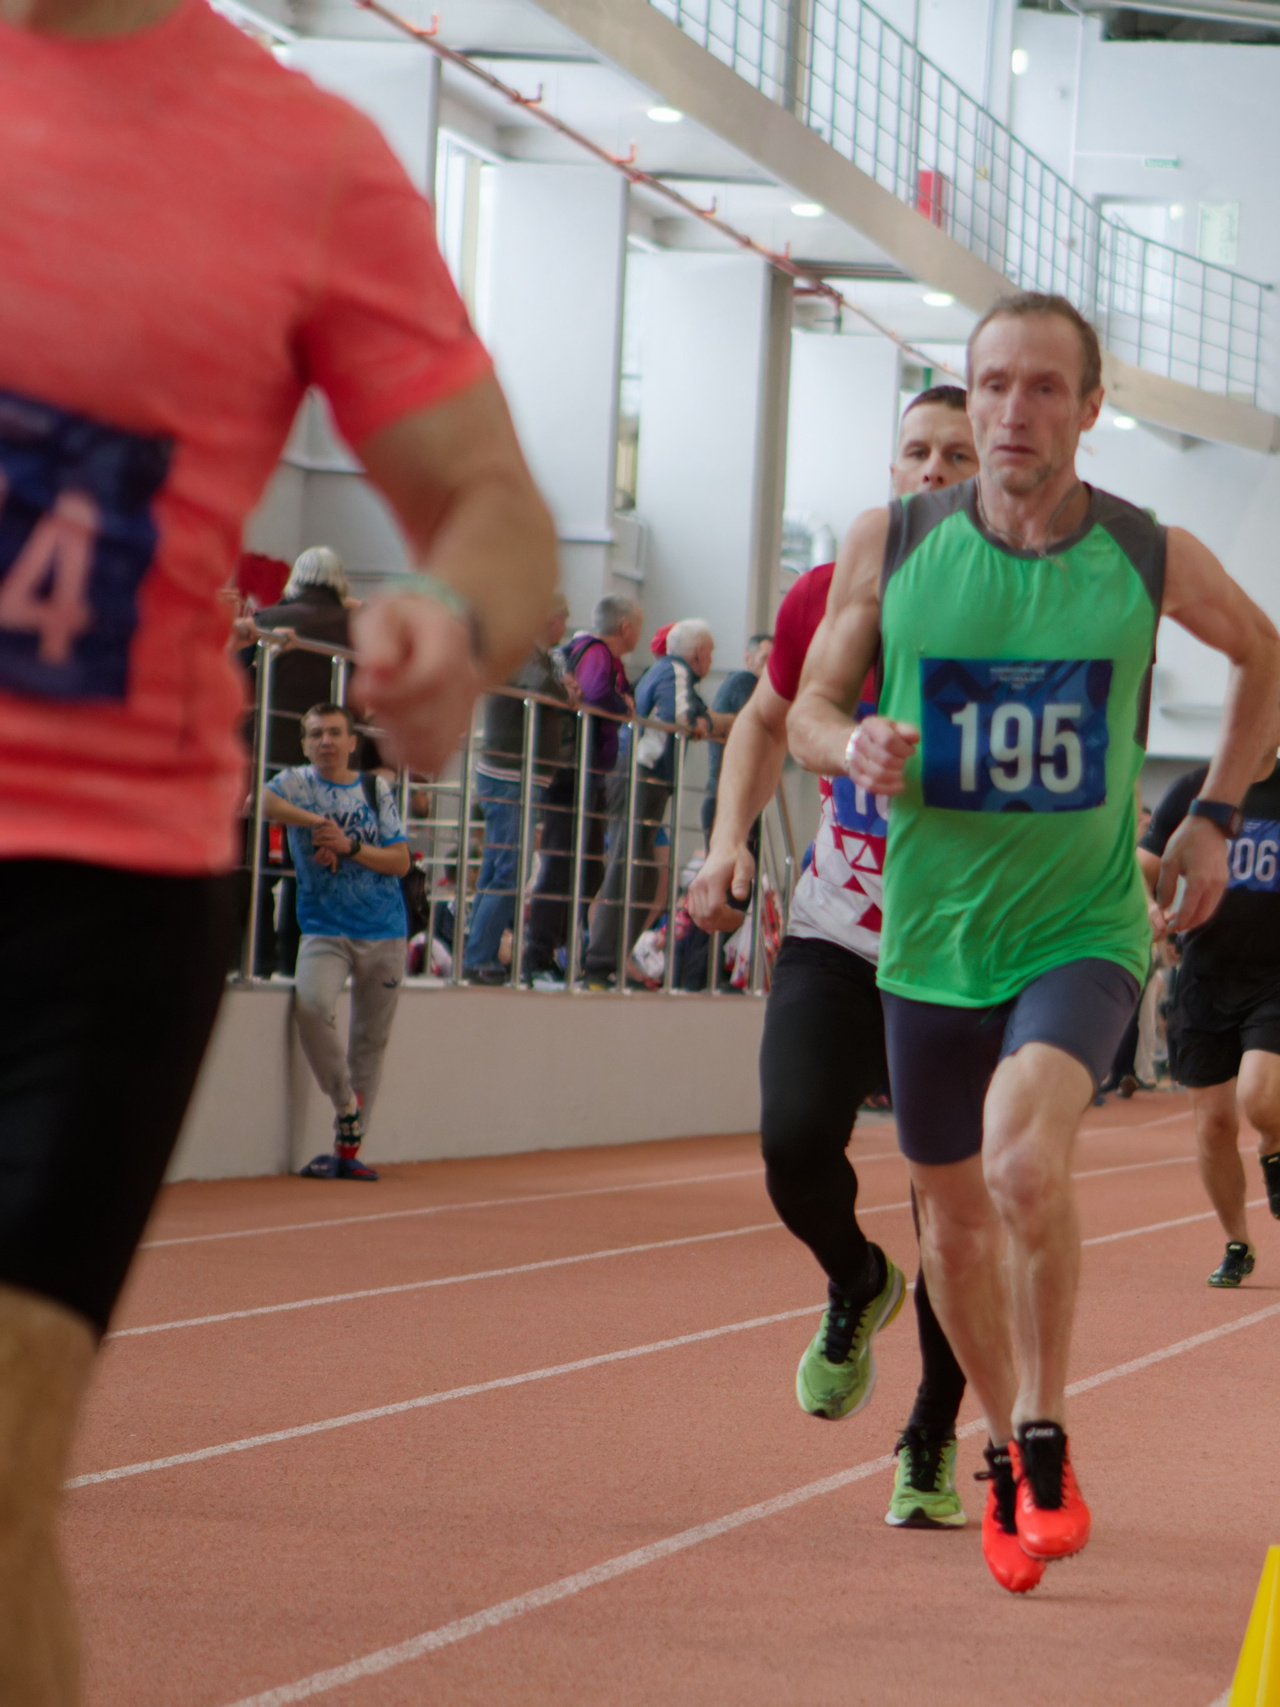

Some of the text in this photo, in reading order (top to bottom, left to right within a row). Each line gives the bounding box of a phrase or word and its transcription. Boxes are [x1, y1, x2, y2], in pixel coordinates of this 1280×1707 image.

[0, 486, 96, 665] 4
[951, 701, 1082, 793] 195
[1226, 837, 1279, 882] 06
